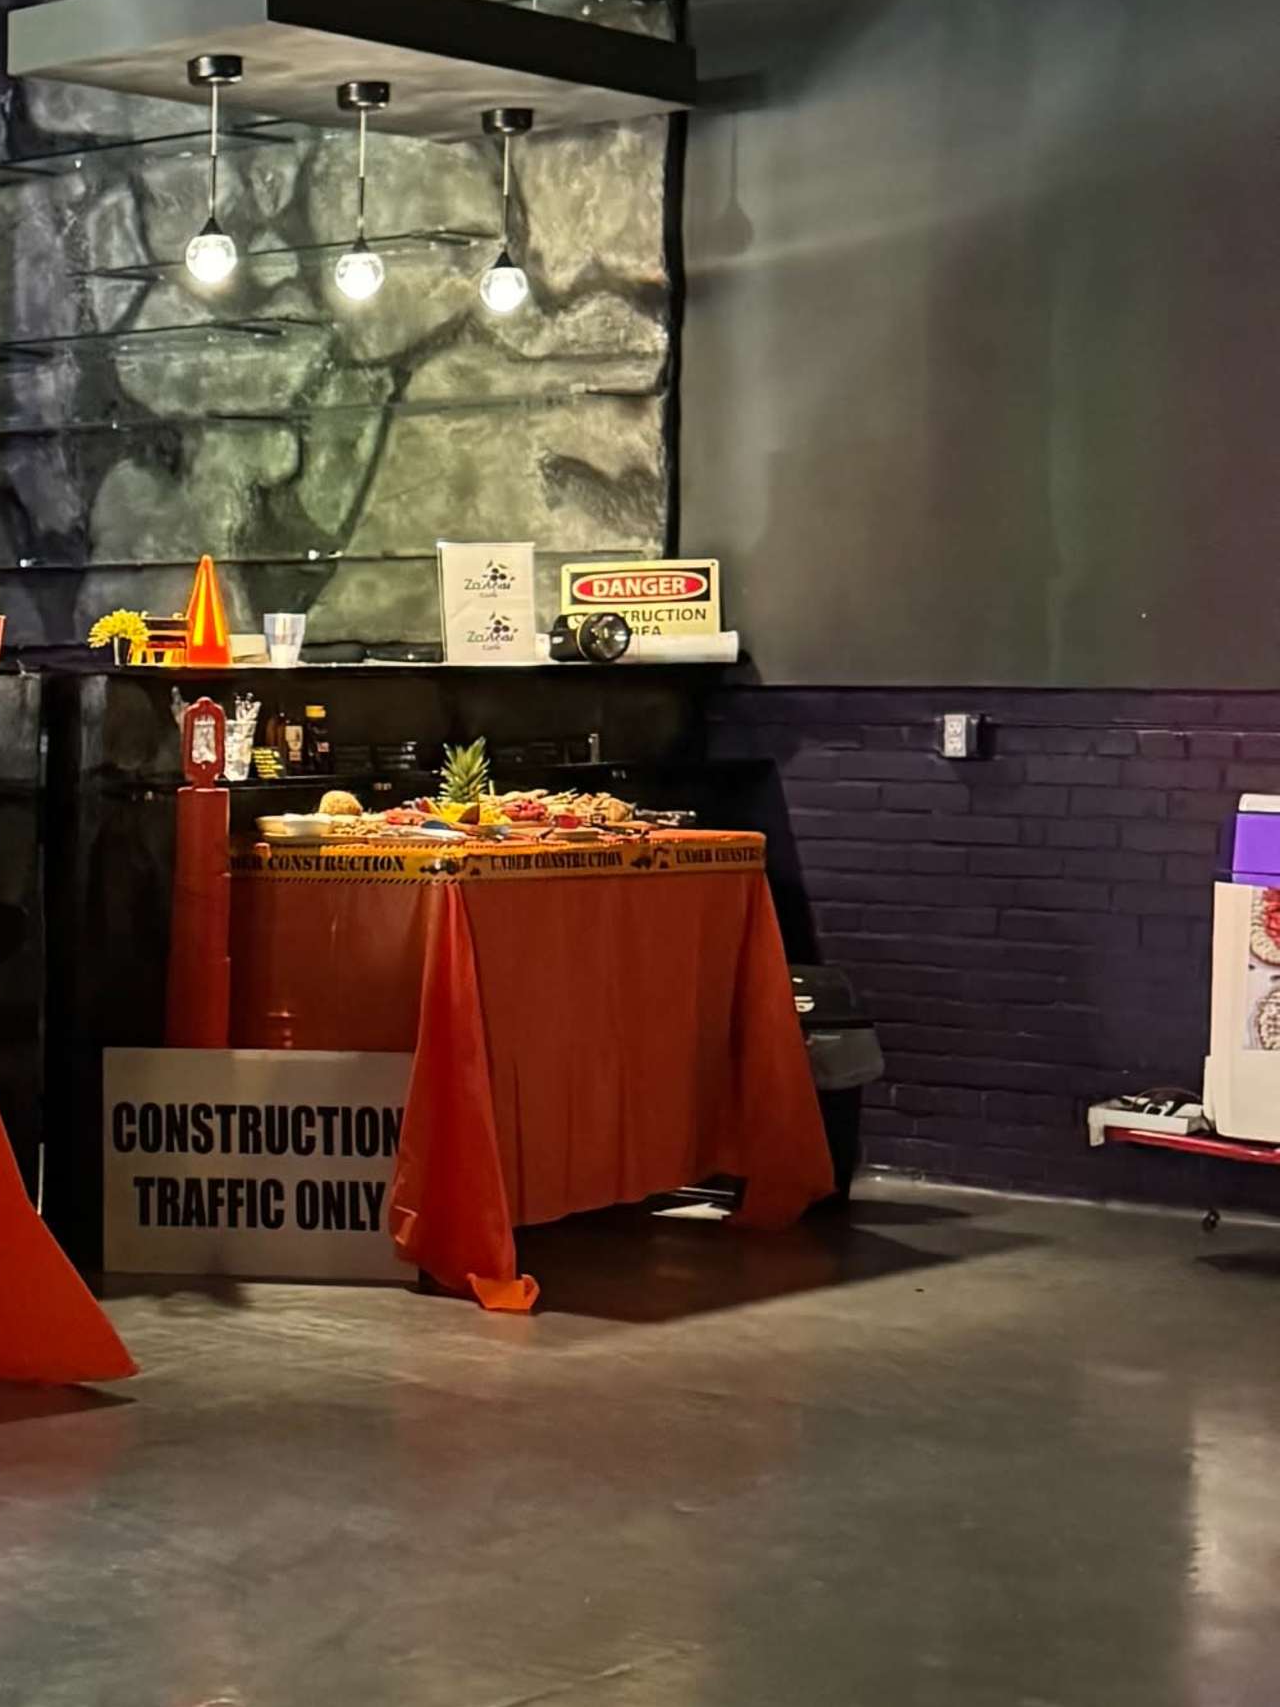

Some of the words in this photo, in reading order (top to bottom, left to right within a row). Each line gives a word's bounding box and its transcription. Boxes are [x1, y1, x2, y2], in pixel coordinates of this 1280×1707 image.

[592, 577, 686, 598] DANGER
[622, 608, 706, 622] TRUCTION
[632, 625, 661, 635] REA
[268, 855, 406, 872] CONSTRUCTION
[490, 852, 531, 871] UNDER
[535, 850, 623, 870] CONSTRUCTION
[676, 848, 713, 865] UNDER
[112, 1102, 404, 1157] CONSTRUCTION
[134, 1176, 285, 1229] TRAFFIC
[295, 1179, 386, 1232] ONLY
